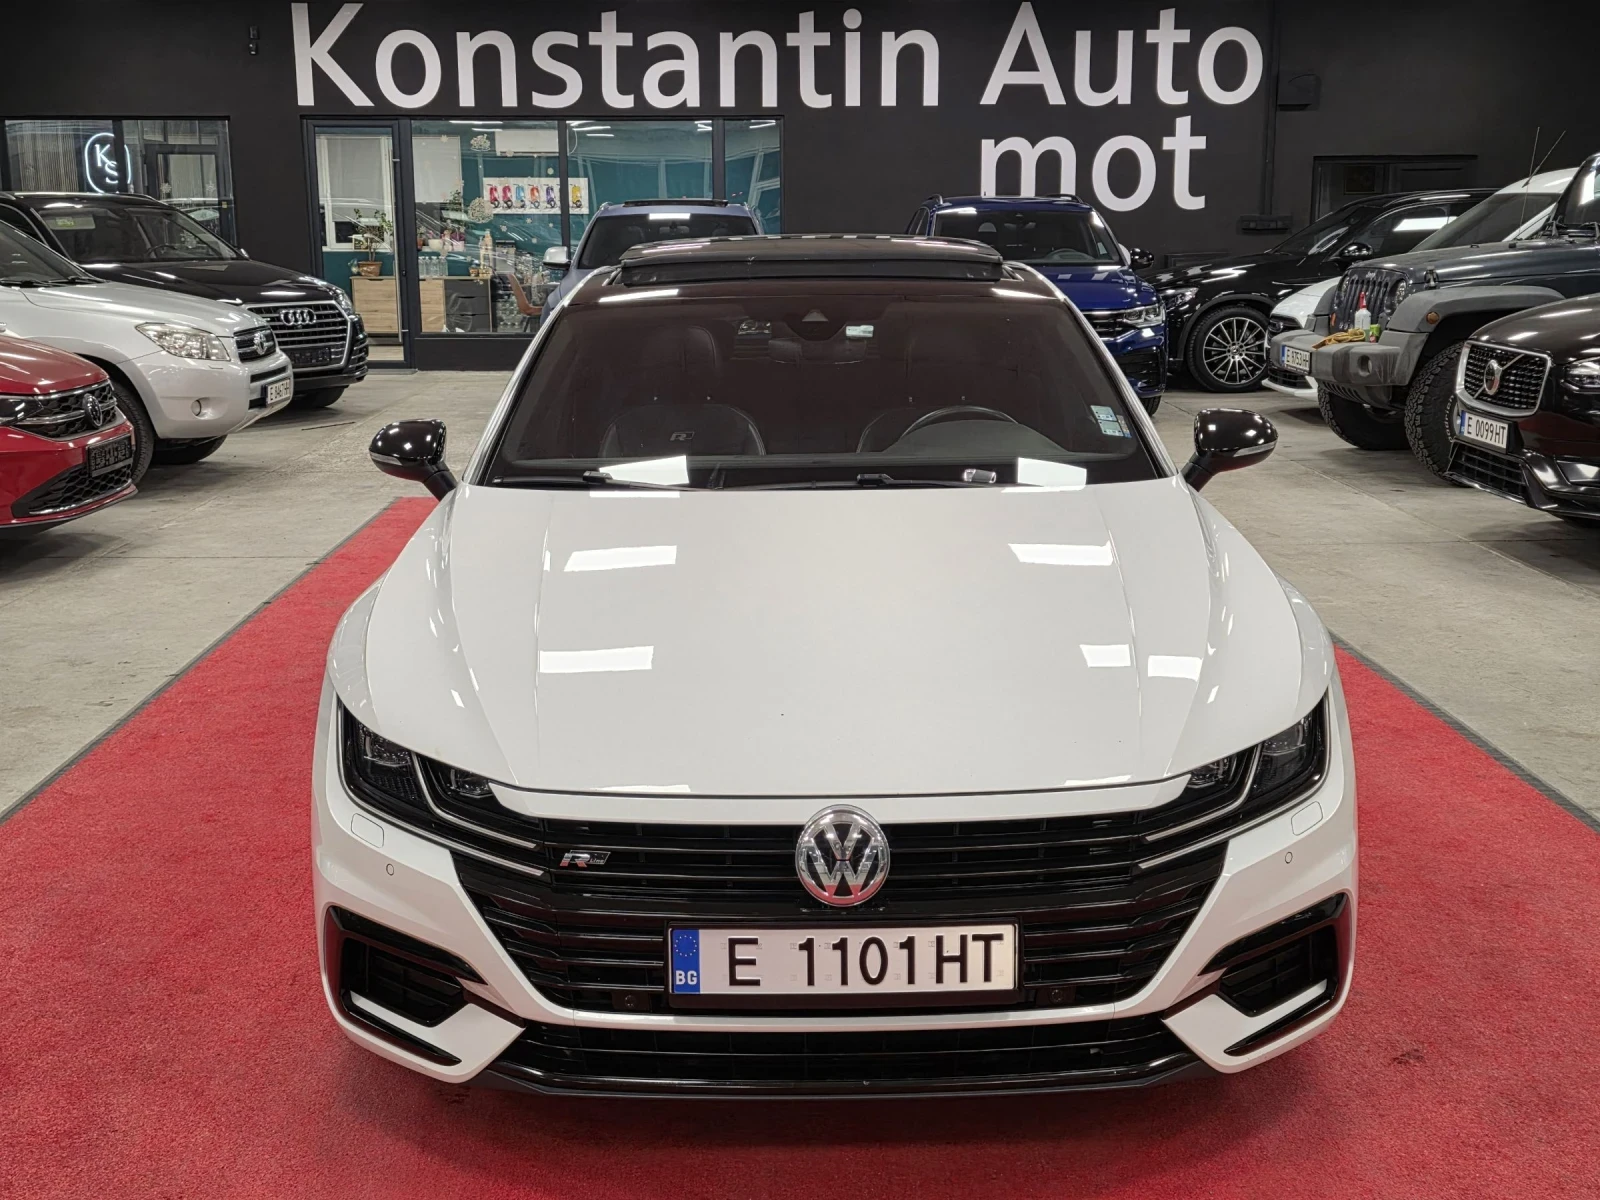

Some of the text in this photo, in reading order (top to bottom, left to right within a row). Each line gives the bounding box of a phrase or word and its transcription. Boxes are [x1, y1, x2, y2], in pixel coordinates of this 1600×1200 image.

[292, 2, 1264, 109] Konstantin Auto
[981, 115, 1207, 212] mot
[1467, 416, 1473, 434] E
[675, 970, 698, 985] BG
[728, 936, 761, 987] E
